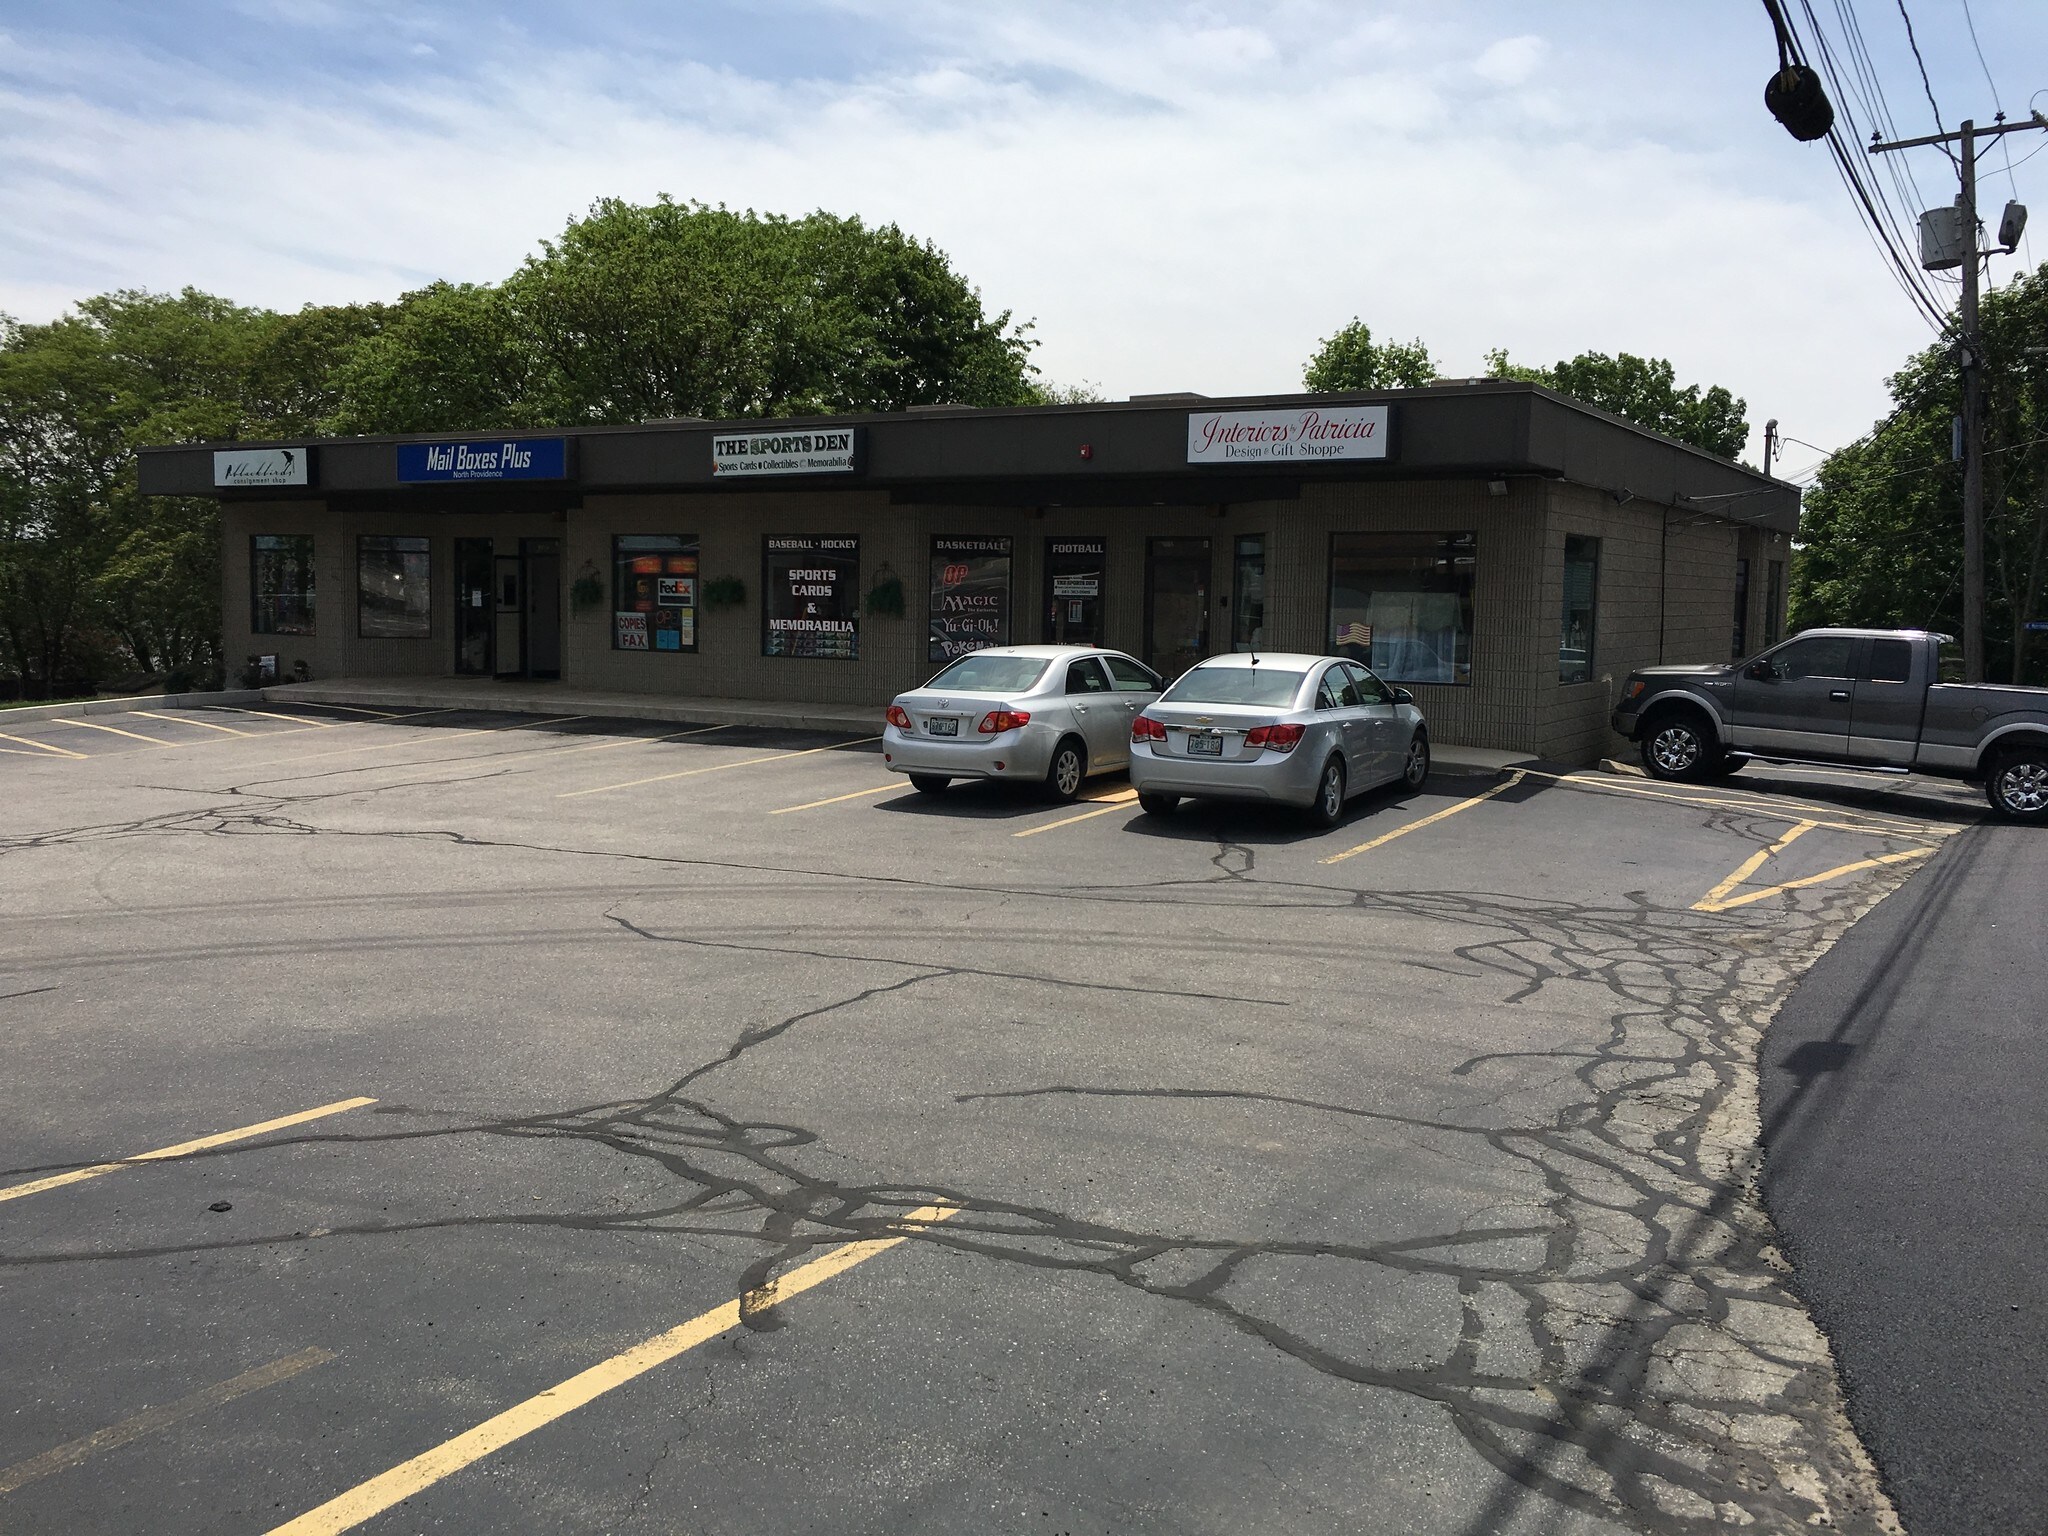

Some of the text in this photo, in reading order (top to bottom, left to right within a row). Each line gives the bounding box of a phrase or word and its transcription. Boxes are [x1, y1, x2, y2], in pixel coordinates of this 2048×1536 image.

[1193, 415, 1289, 454] Interiors
[1290, 411, 1376, 442] Patricia
[716, 434, 850, 456] THE SPORTS DEN
[1225, 445, 1262, 459] Design
[1271, 443, 1294, 456] Gift
[1299, 442, 1345, 457] Shoppe
[427, 443, 532, 470] Mail Boxes Plus
[718, 456, 847, 473] Sports Cards Collectibles Memorabilia
[453, 470, 503, 479] North Providence
[768, 540, 857, 549] BASEBALL HOCKEY
[936, 540, 1007, 550] BASKETBALL
[1052, 544, 1104, 553] FOOTBALL
[788, 569, 837, 581] SPORTS
[660, 580, 691, 594] FedEx
[791, 585, 832, 597] CARDS
[807, 602, 817, 614] &
[619, 616, 646, 630] COPIES
[769, 619, 855, 633] MEMORABILIA
[941, 617, 999, 633] Yu-Gi-Oh!
[622, 634, 645, 646] FAX
